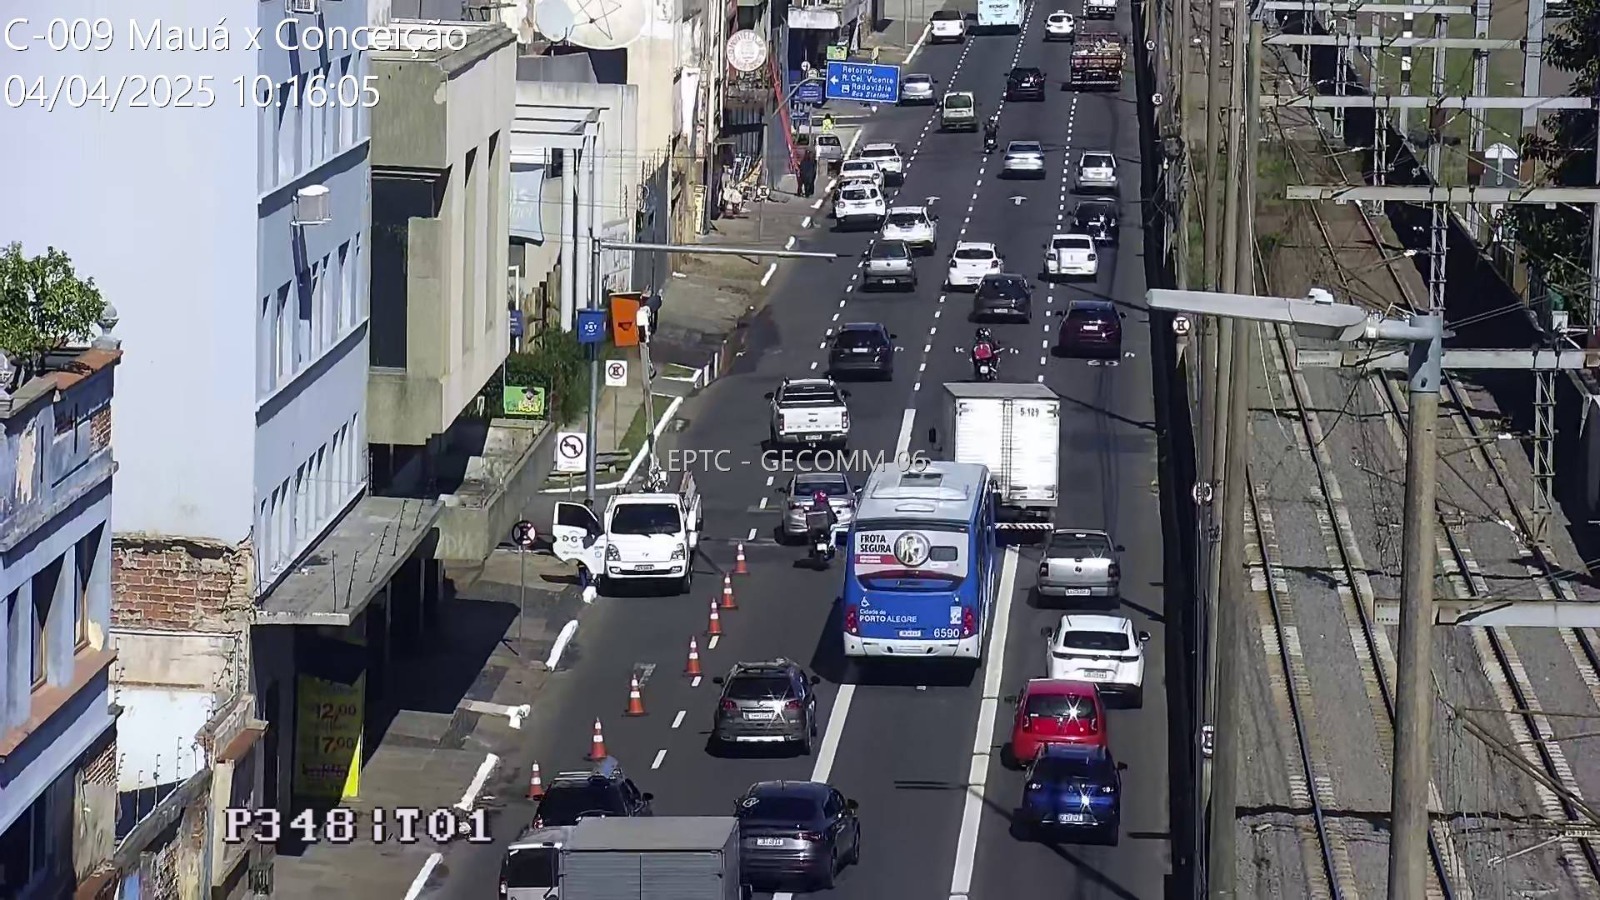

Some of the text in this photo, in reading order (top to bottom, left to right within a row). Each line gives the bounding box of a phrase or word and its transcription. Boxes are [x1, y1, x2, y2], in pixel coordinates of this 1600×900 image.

[860, 534, 886, 543] FROTA
[860, 544, 891, 553] SEGURA
[859, 615, 917, 624] PORTO ALEGRE
[933, 628, 960, 639] 6590
